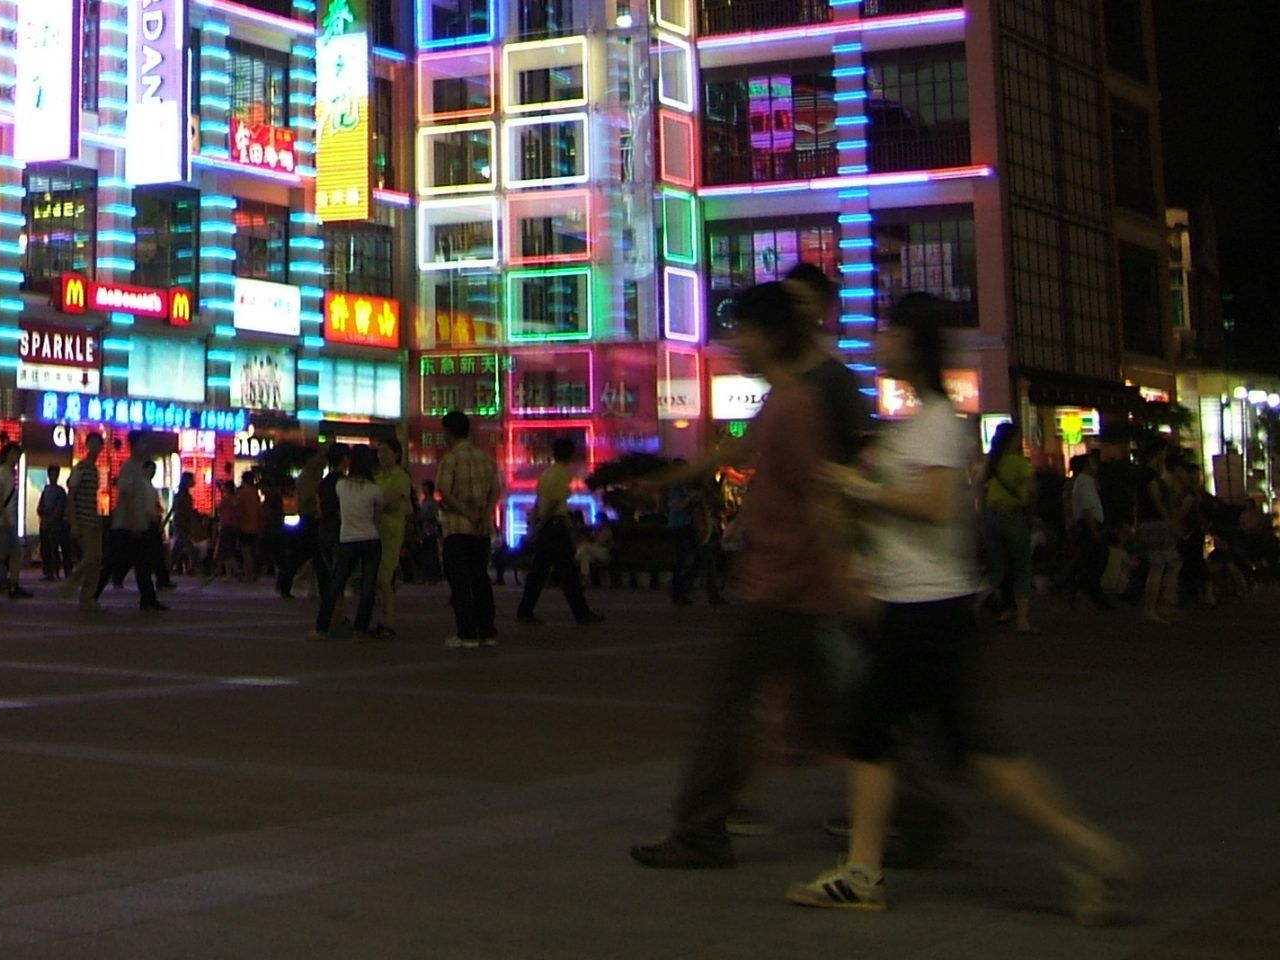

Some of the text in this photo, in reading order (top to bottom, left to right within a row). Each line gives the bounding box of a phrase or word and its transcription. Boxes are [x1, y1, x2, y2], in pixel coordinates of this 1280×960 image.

[19, 329, 95, 363] SPARKLE
[418, 356, 518, 376] 东急新天地
